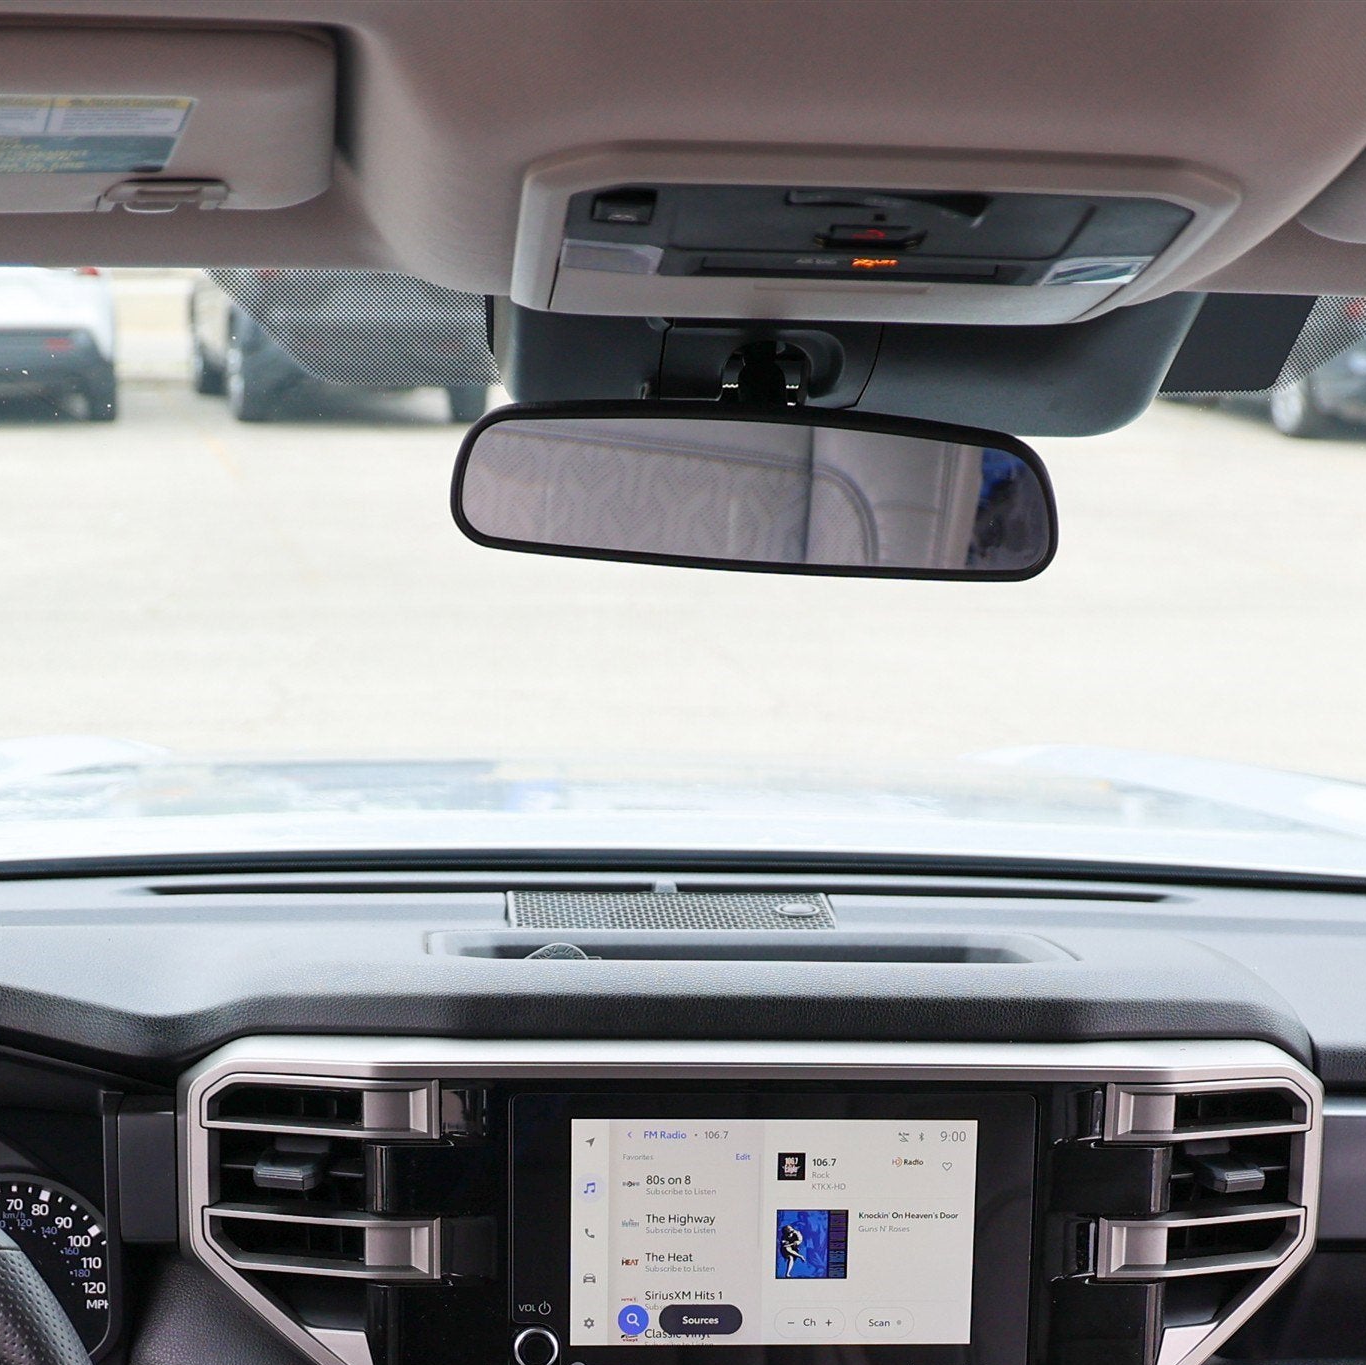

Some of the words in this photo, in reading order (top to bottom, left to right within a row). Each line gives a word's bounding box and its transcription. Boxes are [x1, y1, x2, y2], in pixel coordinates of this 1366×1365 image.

[643, 1130, 658, 1139] FM
[660, 1130, 687, 1139] Radio
[704, 1130, 729, 1139] 106.7
[940, 1131, 966, 1142] 9:00
[622, 1153, 654, 1161] Favorites
[735, 1153, 751, 1161] Edit
[812, 1158, 837, 1167] 106.7
[903, 1158, 924, 1166] Radio
[811, 1171, 829, 1179] Rock
[646, 1175, 665, 1185] 80s
[667, 1177, 681, 1185] on
[684, 1175, 691, 1185] 8
[645, 1188, 683, 1196] Subscribe
[684, 1188, 692, 1196] to
[694, 1188, 717, 1196] Listen
[6, 1199, 23, 1211] 70
[31, 1204, 49, 1216] 80
[2, 1211, 26, 1220] km/h
[858, 1211, 890, 1219] Knockin'
[892, 1211, 904, 1219] On
[905, 1211, 938, 1219] Heaven's
[939, 1211, 959, 1219] Door
[17, 1218, 32, 1227] 120
[55, 1217, 72, 1228] 90
[646, 1214, 666, 1223] The
[668, 1214, 716, 1226] Highway
[40, 1226, 57, 1235] 140
[645, 1226, 682, 1234] Subscribe
[694, 1226, 716, 1234] Listen
[858, 1225, 879, 1233] Guns
[888, 1225, 910, 1233] Roses
[67, 1235, 91, 1247] 100
[63, 1247, 79, 1255] 160
[645, 1252, 665, 1262] The
[667, 1252, 693, 1262] Heat
[81, 1257, 102, 1269] 110
[74, 1269, 90, 1278] 180
[645, 1265, 681, 1273] Subscribe
[683, 1265, 691, 1273] to
[693, 1265, 715, 1273] Listen
[82, 1282, 106, 1294] 120
[645, 1291, 692, 1301] SiriusXM
[694, 1291, 715, 1301] Hits
[718, 1291, 723, 1301] 1
[518, 1304, 536, 1312] VOL
[682, 1316, 719, 1325] Sources
[803, 1318, 816, 1327] Ch
[868, 1318, 890, 1328] Scan
